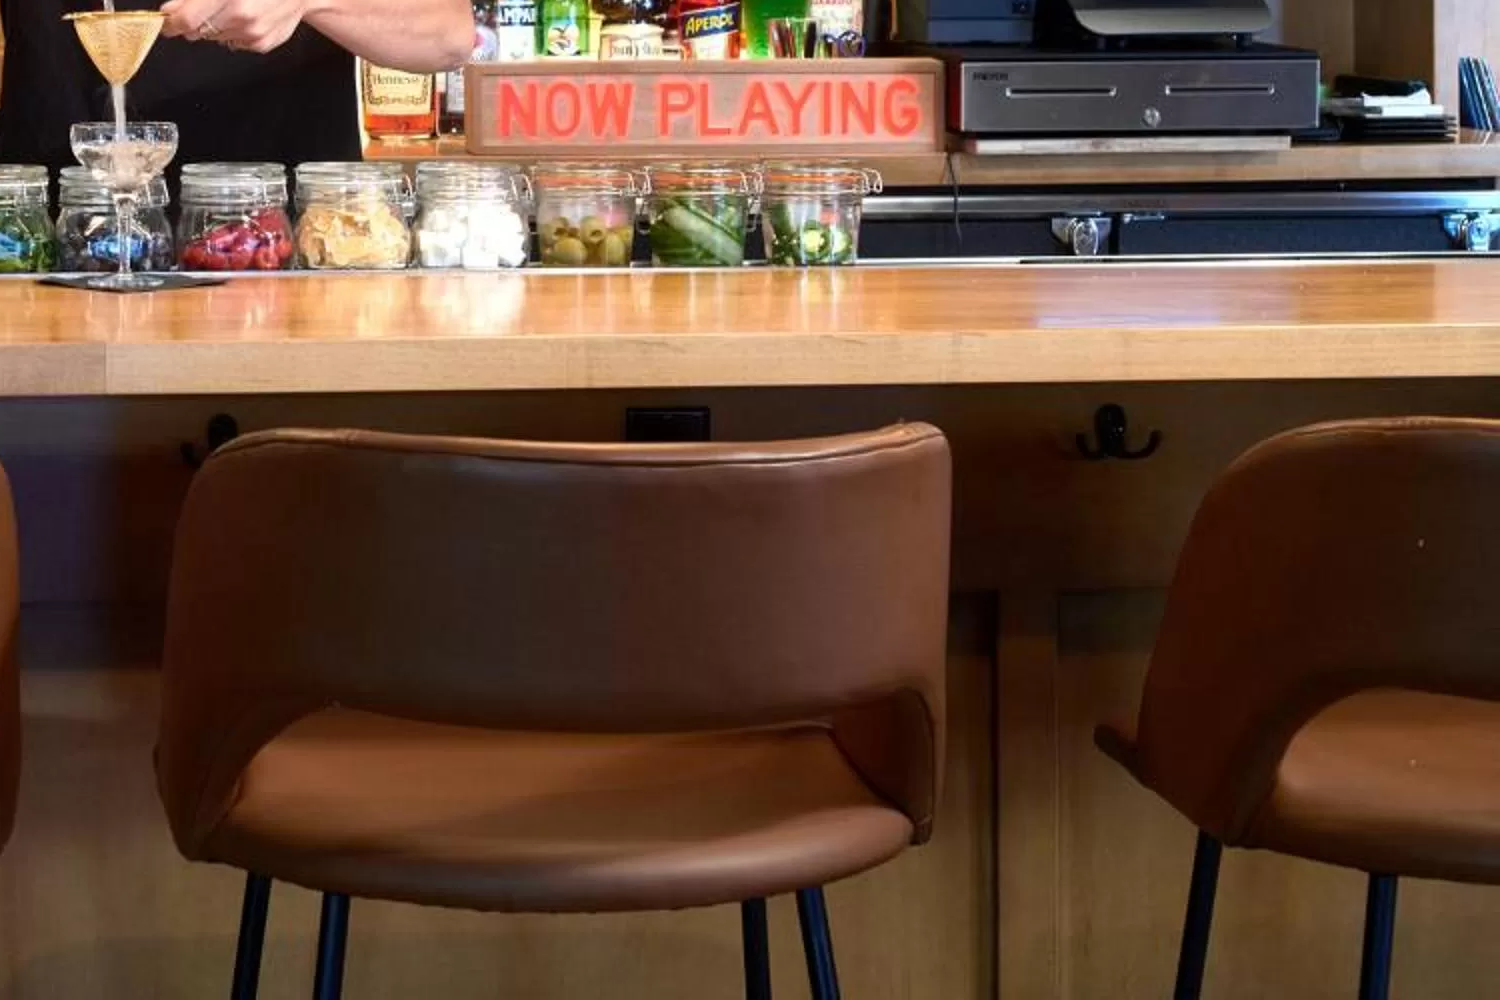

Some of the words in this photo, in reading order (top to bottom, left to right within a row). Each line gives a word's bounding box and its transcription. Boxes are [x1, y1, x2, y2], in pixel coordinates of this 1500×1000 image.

[499, 6, 536, 23] AMPA
[685, 13, 735, 36] APEROL
[499, 81, 635, 138] NOW
[656, 79, 921, 138] PLAYING
